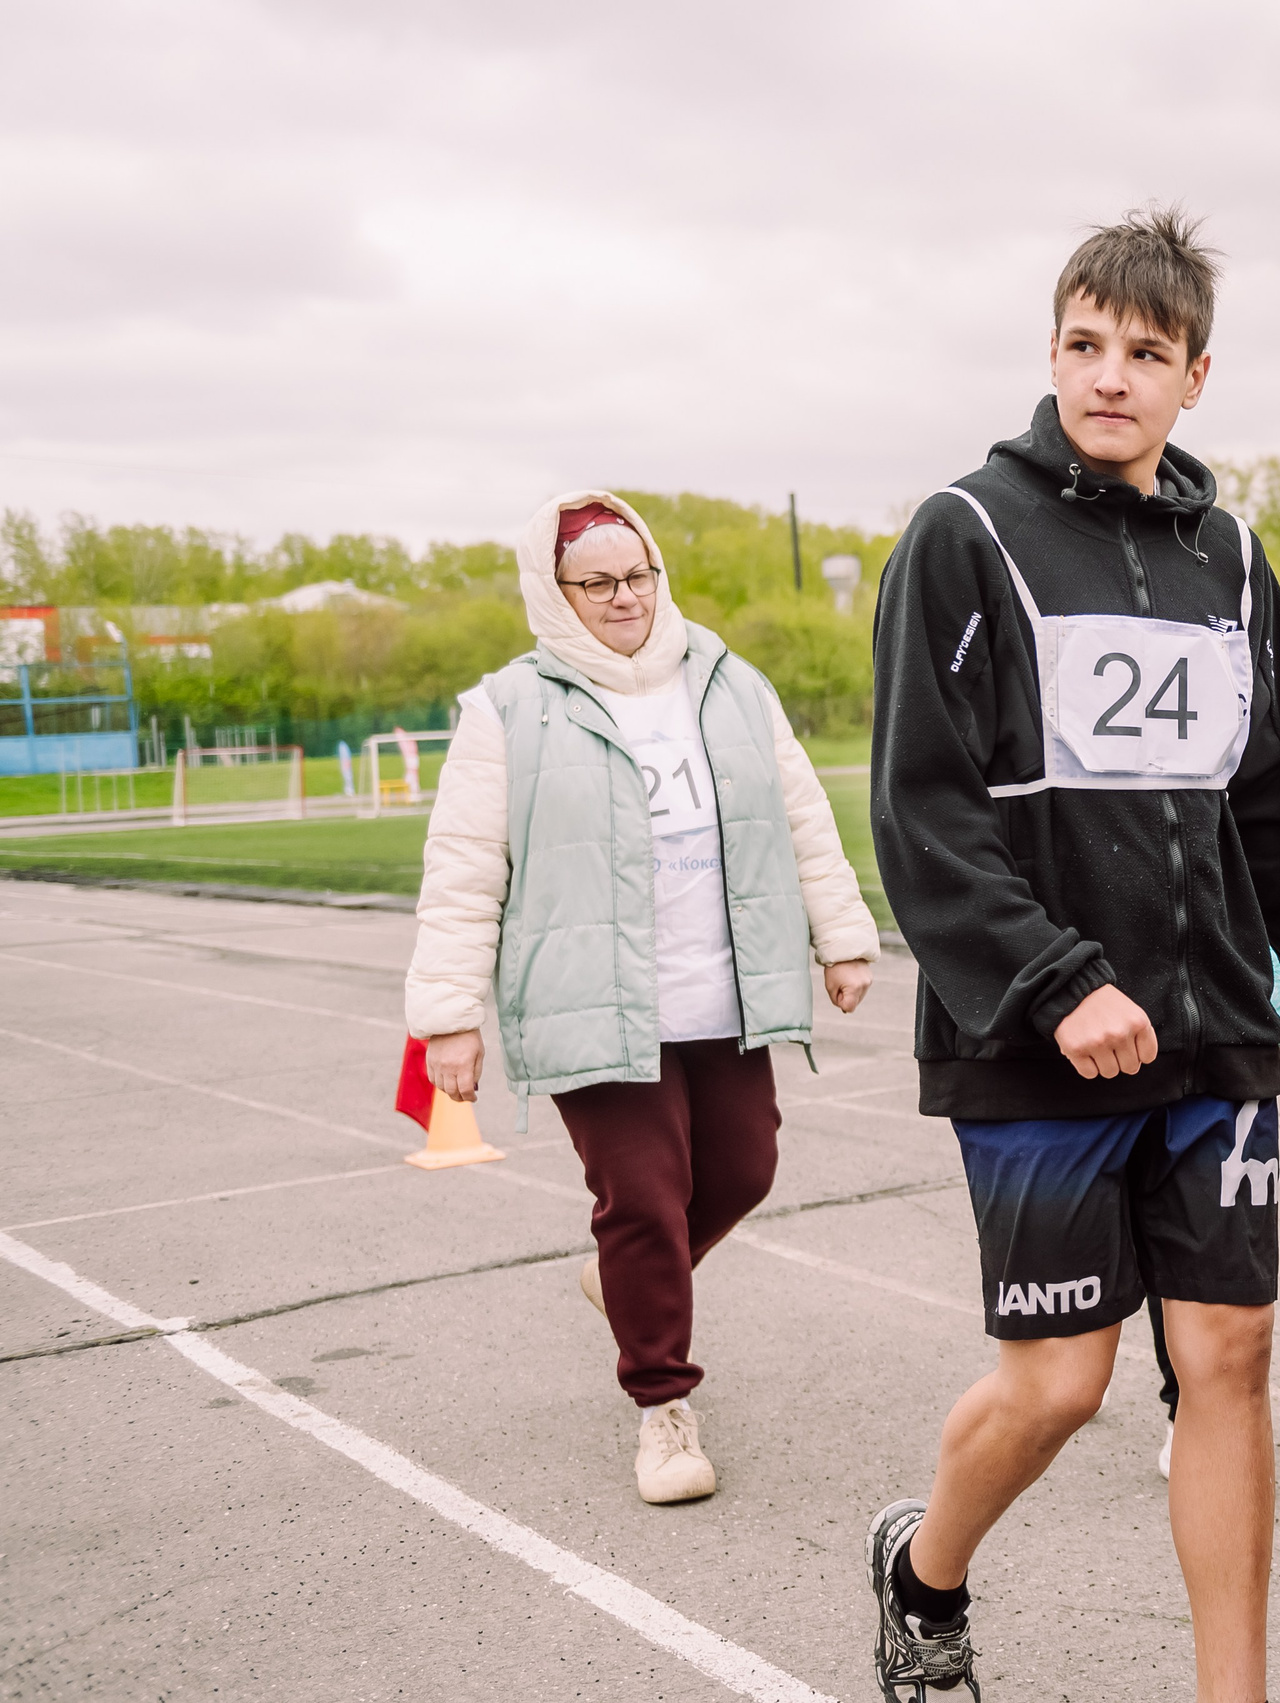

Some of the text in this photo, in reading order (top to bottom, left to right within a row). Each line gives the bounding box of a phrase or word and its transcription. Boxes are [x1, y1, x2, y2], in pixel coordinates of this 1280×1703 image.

[1092, 652, 1198, 740] 24
[640, 758, 703, 818] 21
[994, 1275, 1102, 1317] ANTO
